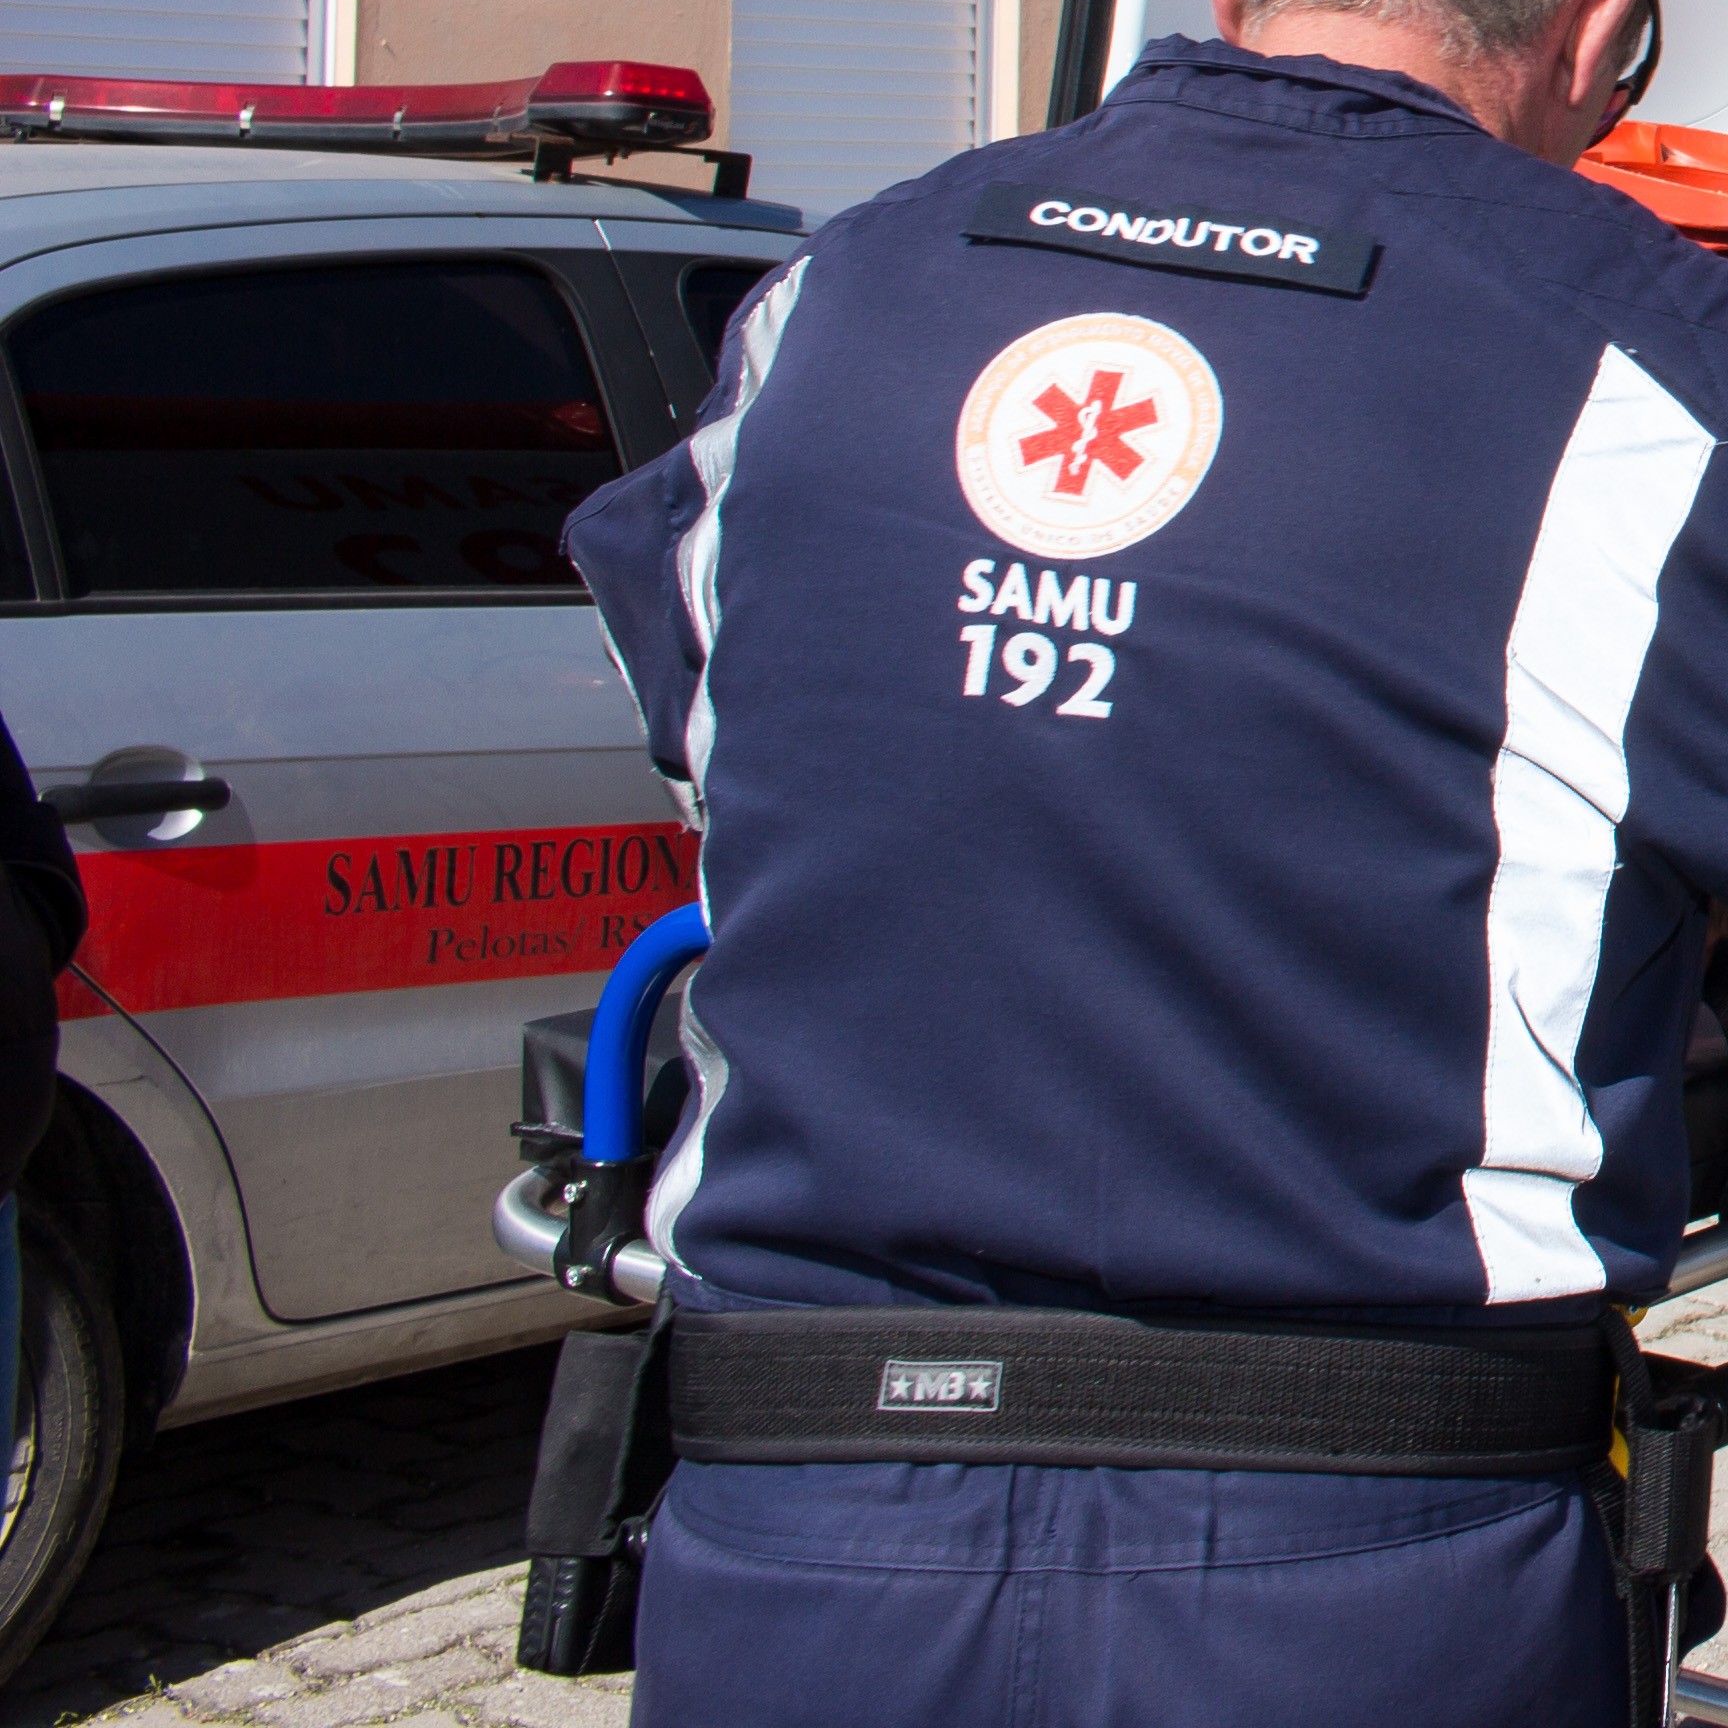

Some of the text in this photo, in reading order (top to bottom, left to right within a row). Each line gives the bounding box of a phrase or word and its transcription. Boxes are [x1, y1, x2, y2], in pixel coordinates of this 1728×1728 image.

[1029, 200, 1322, 264] CONDUTOR
[958, 558, 1137, 636] SAMU
[960, 624, 1117, 718] 192
[324, 845, 477, 917] SAMU
